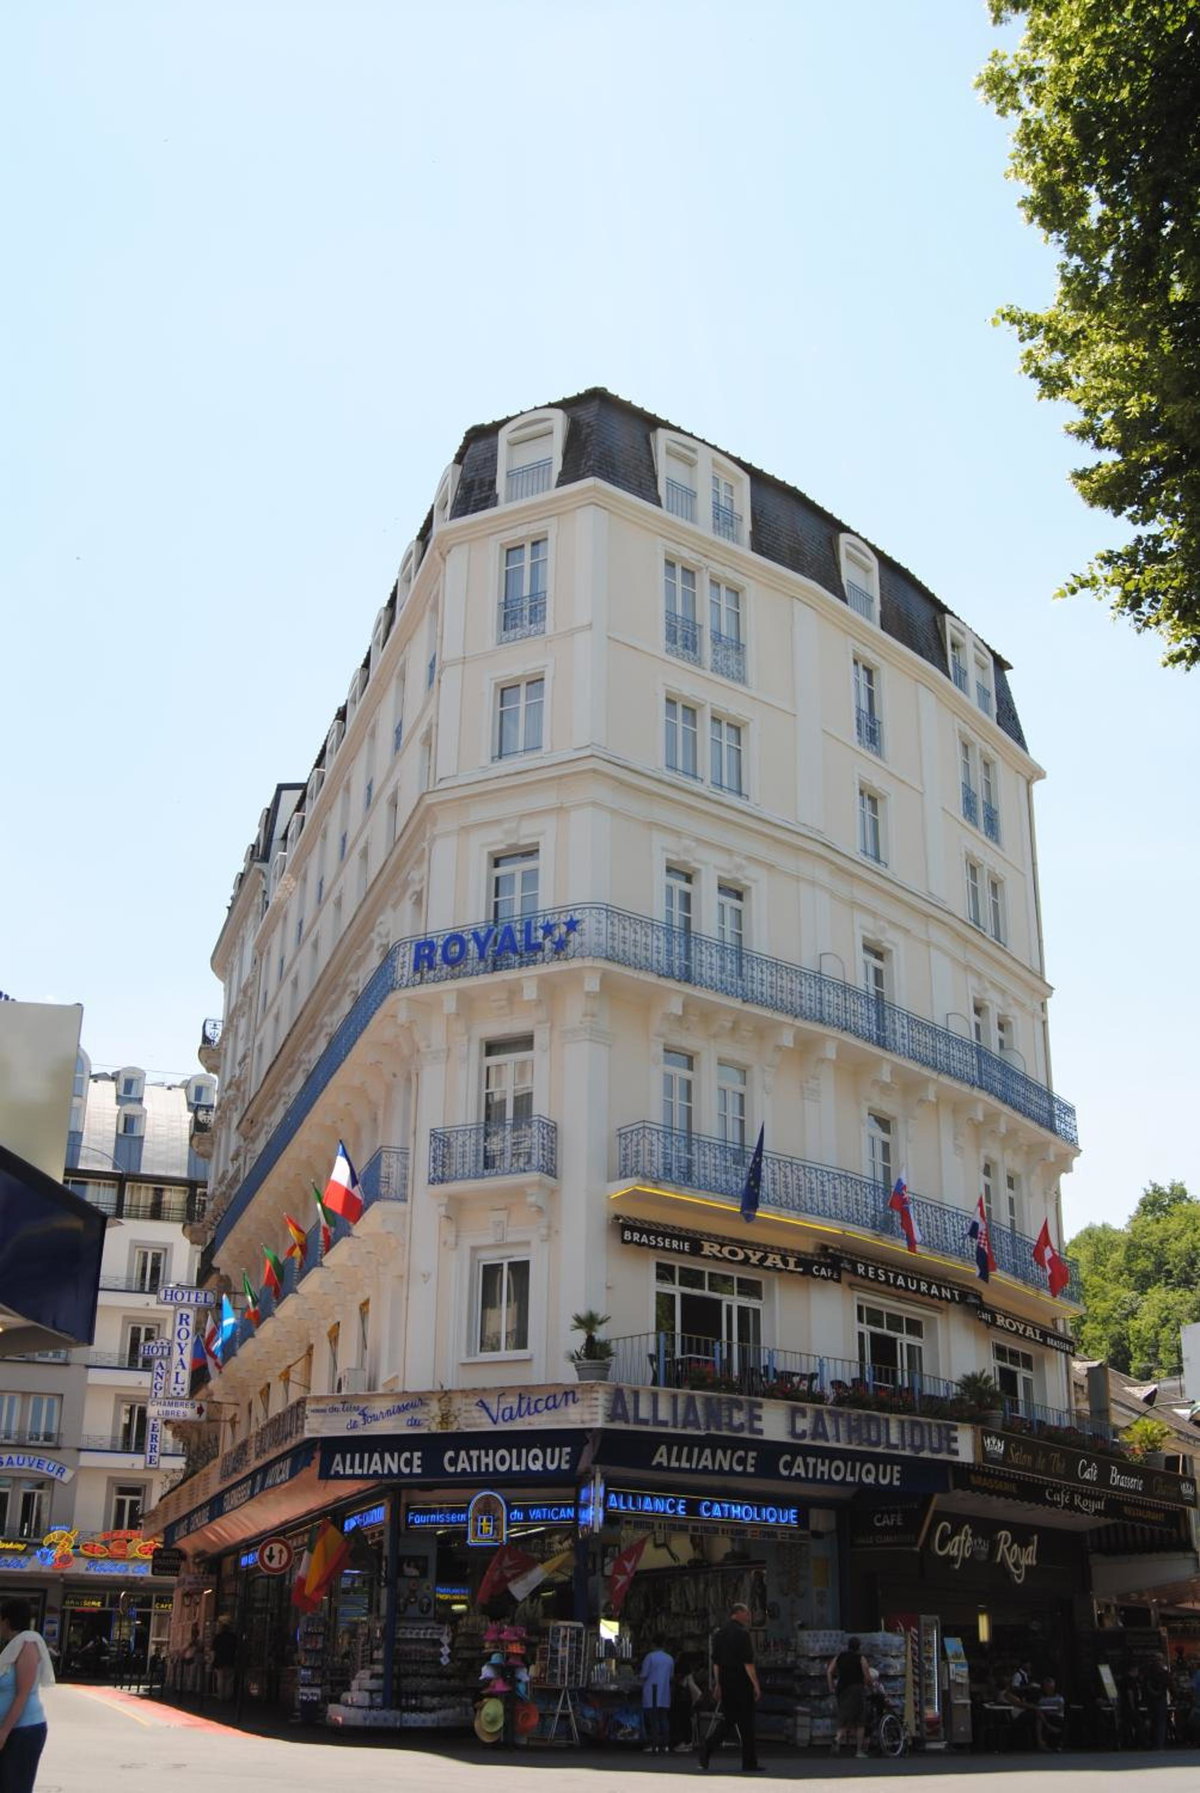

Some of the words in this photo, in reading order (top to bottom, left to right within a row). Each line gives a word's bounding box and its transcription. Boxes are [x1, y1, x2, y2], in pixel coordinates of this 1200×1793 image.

[413, 919, 542, 972] ROYAL
[624, 1230, 691, 1252] BRASSERIE
[700, 1241, 803, 1272] ROYAL
[163, 1289, 213, 1304] HOTEL
[857, 1262, 962, 1302] RESTAURANT
[174, 1313, 190, 1385] ROYAL
[995, 1313, 1043, 1342] ROYAL
[1047, 1336, 1074, 1355] BRASSERIE
[150, 1400, 196, 1409] CHAMBRES
[157, 1409, 187, 1417] LIBRES
[358, 1398, 423, 1425] Fournisseur
[475, 1390, 579, 1425] Vatican
[406, 1416, 423, 1427] du
[609, 1388, 764, 1436] ALLIANCE
[790, 1406, 960, 1456] CATHOLIQUE
[330, 1451, 422, 1475] ALLIANCE
[444, 1447, 572, 1473] CATHOLIQUE
[652, 1445, 757, 1473] ALLIANCE
[778, 1454, 902, 1486] CATHOLIQUE
[1077, 1459, 1098, 1482] Café
[1109, 1465, 1144, 1491] Brasserie
[509, 1509, 523, 1521] du
[529, 1508, 575, 1520] VATICAN
[608, 1493, 687, 1515] ALLIANCE
[700, 1500, 798, 1524] CATHOLIQUE
[1045, 1487, 1070, 1508] Café
[1074, 1495, 1106, 1513] Royal
[935, 1521, 973, 1569] Café
[996, 1530, 1038, 1584] Royal
